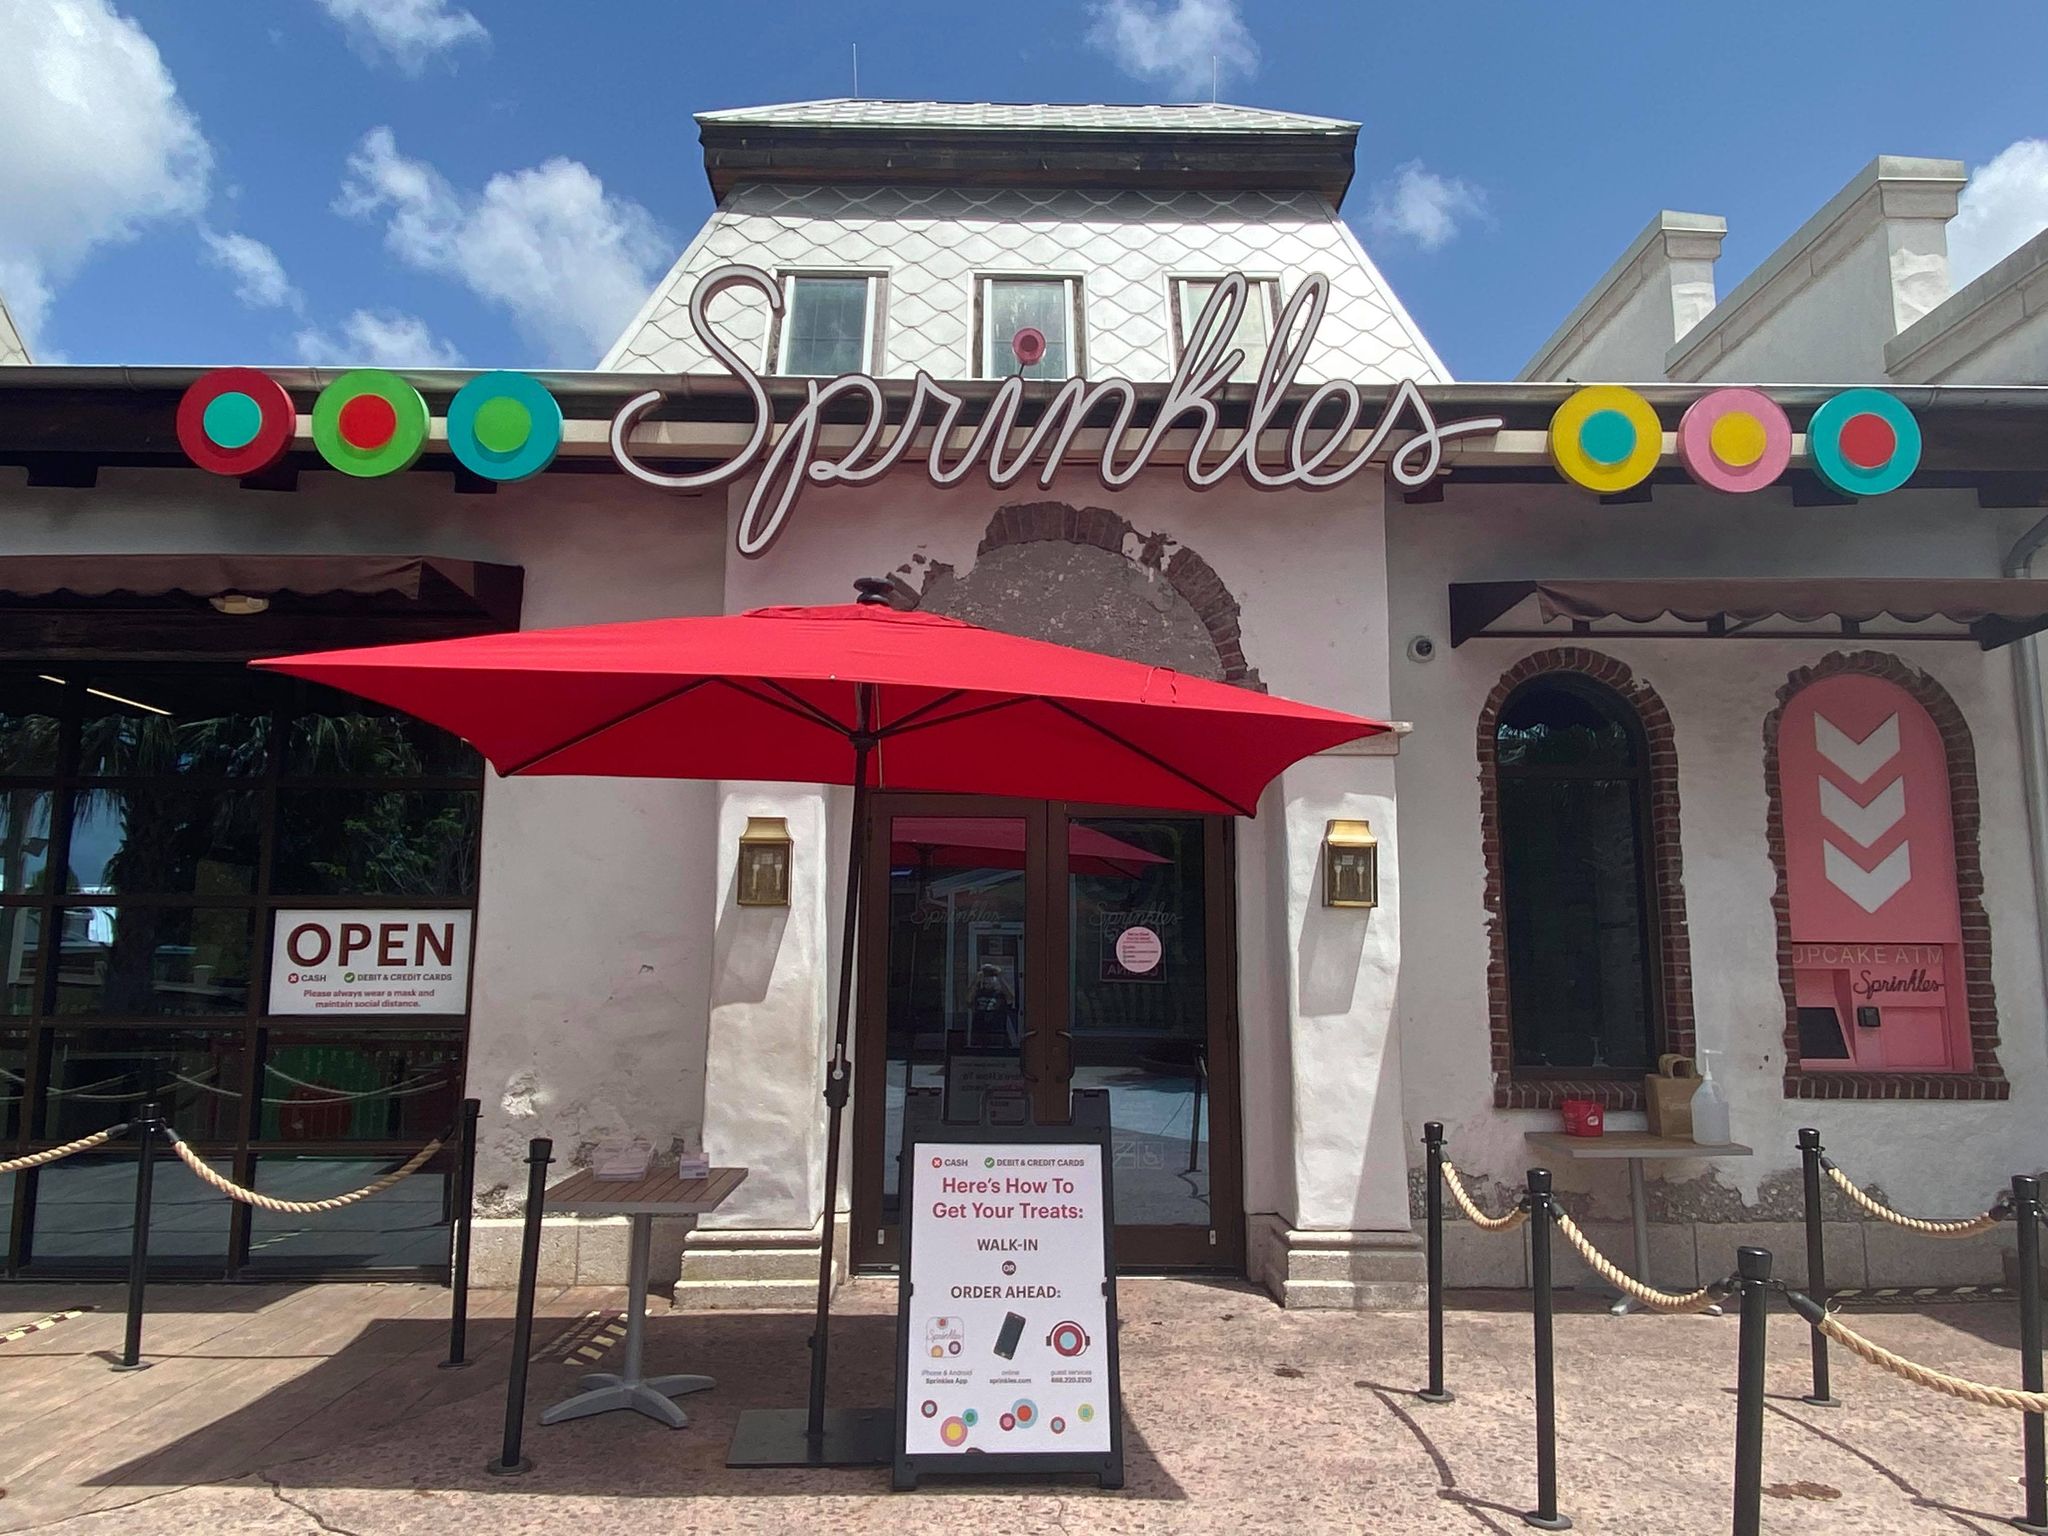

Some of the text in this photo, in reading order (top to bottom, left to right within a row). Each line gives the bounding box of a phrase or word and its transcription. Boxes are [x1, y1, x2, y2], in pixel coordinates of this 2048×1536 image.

[610, 263, 1504, 558] Sprinkles
[287, 923, 454, 967] OPEN
[1792, 946, 1944, 964] UPCAKE ATM
[301, 974, 327, 982] CASH
[390, 973, 421, 981] CREDIT
[423, 973, 452, 981] CARDS
[1853, 969, 1944, 999] Sprinkles
[304, 989, 331, 998] Please
[333, 989, 362, 998] always
[394, 989, 417, 997] mask
[418, 989, 435, 997] and
[315, 1000, 421, 1008] maintain social distance.
[944, 1159, 968, 1167] CASH
[996, 1159, 1084, 1167] DEBIT & CREDIT CARDS
[942, 1177, 1075, 1194] Here's How To
[932, 1202, 1083, 1219] Get Your Treats:
[977, 1238, 1038, 1251] WALK-IN
[1003, 1263, 1016, 1273] OR
[951, 1286, 1061, 1299] ORDER AHEAD:
[955, 1377, 968, 1385] App
